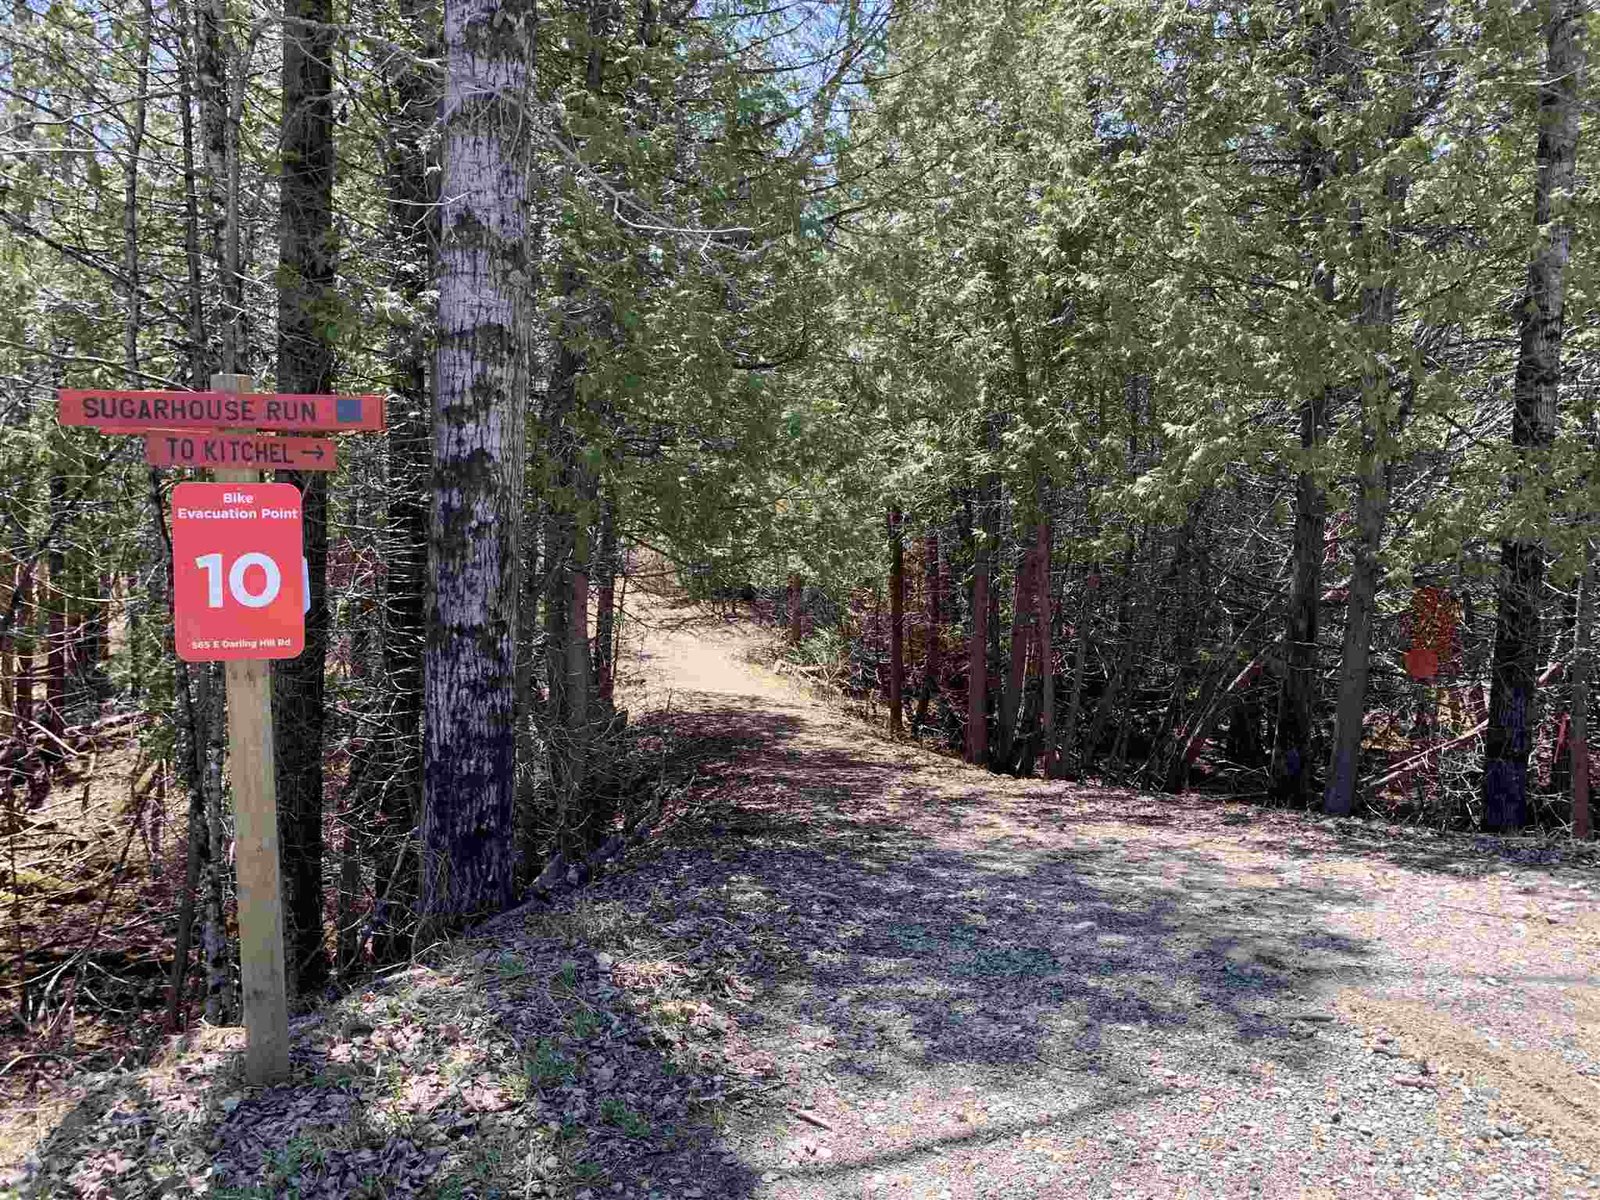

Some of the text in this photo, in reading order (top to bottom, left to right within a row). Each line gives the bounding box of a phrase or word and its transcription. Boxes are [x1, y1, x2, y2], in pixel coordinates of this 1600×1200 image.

[82, 398, 316, 422] SUGARHOUSE RUN
[166, 437, 294, 464] TO KITCHEL
[223, 492, 254, 503] Bike
[177, 508, 298, 519] Evacuation Point
[194, 552, 281, 608] 10
[213, 640, 220, 648] E
[222, 638, 257, 649] Darling
[260, 638, 275, 647] Hill
[277, 638, 291, 646] Rd
